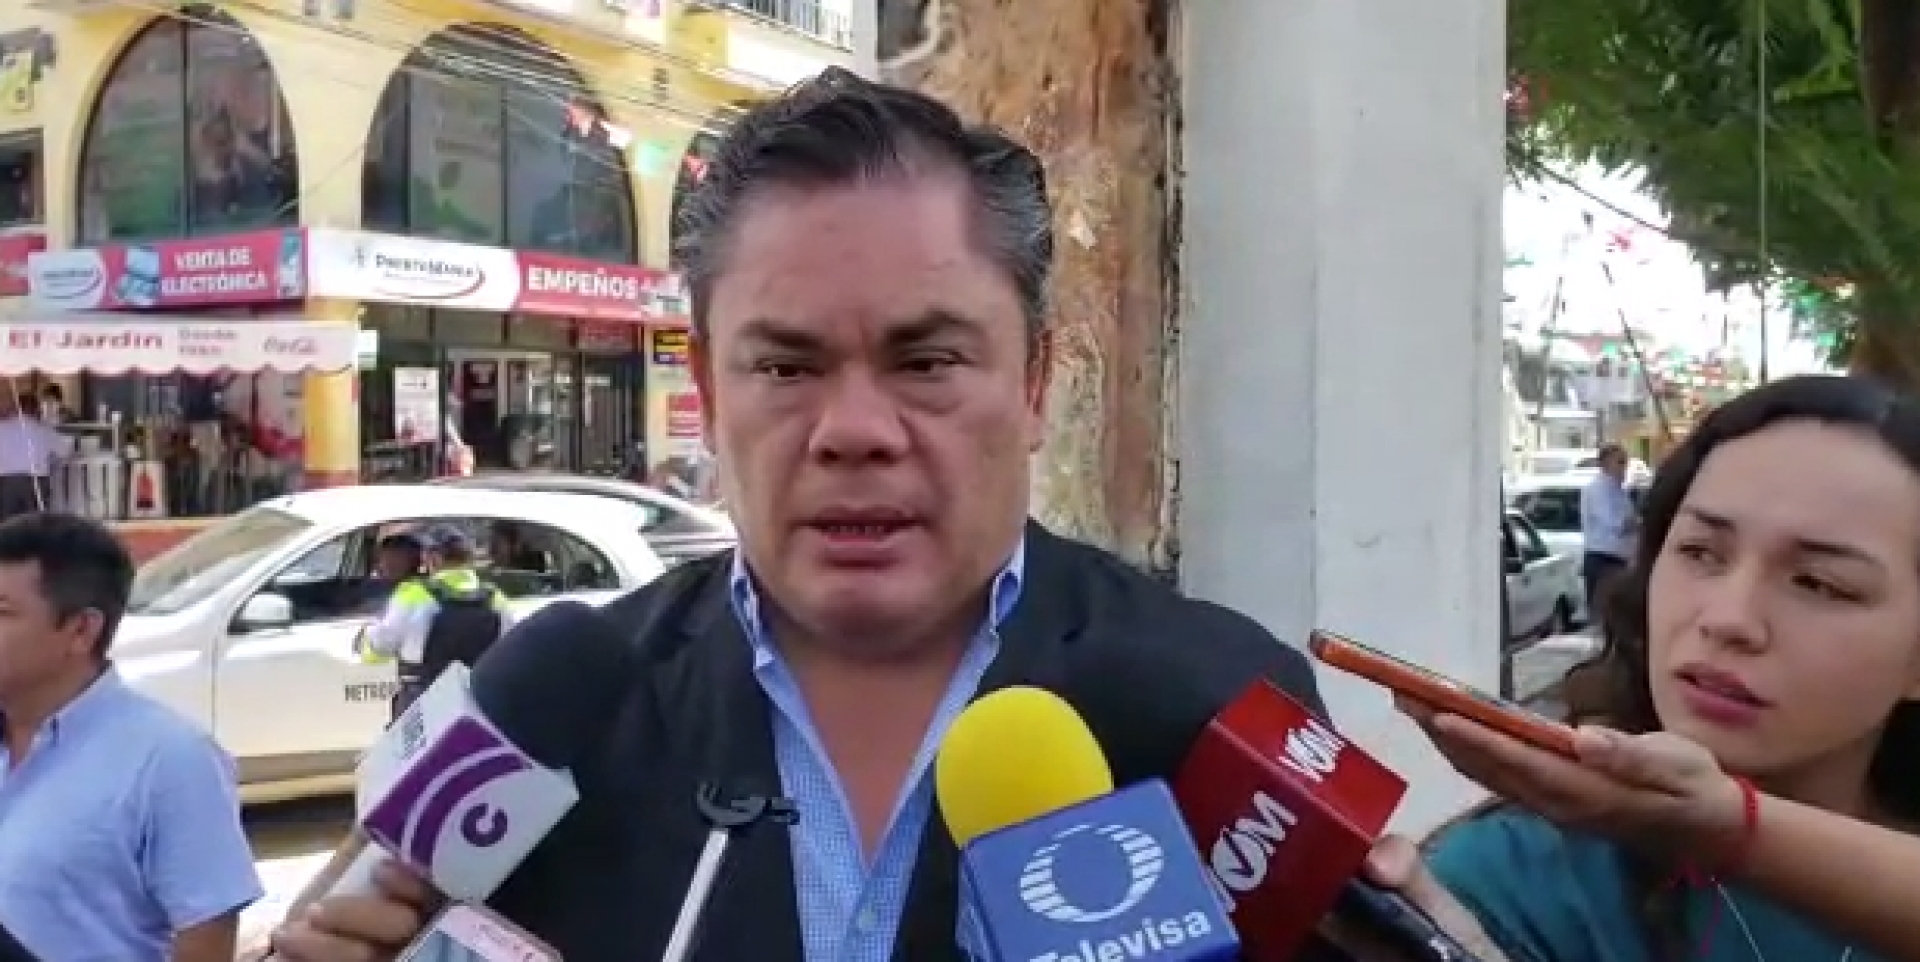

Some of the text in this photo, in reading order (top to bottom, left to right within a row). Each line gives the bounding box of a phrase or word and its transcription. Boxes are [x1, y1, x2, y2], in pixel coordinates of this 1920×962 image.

[175, 246, 251, 270] VENTA DE
[528, 265, 639, 300] EMPEÑOS
[8, 330, 42, 349] El
